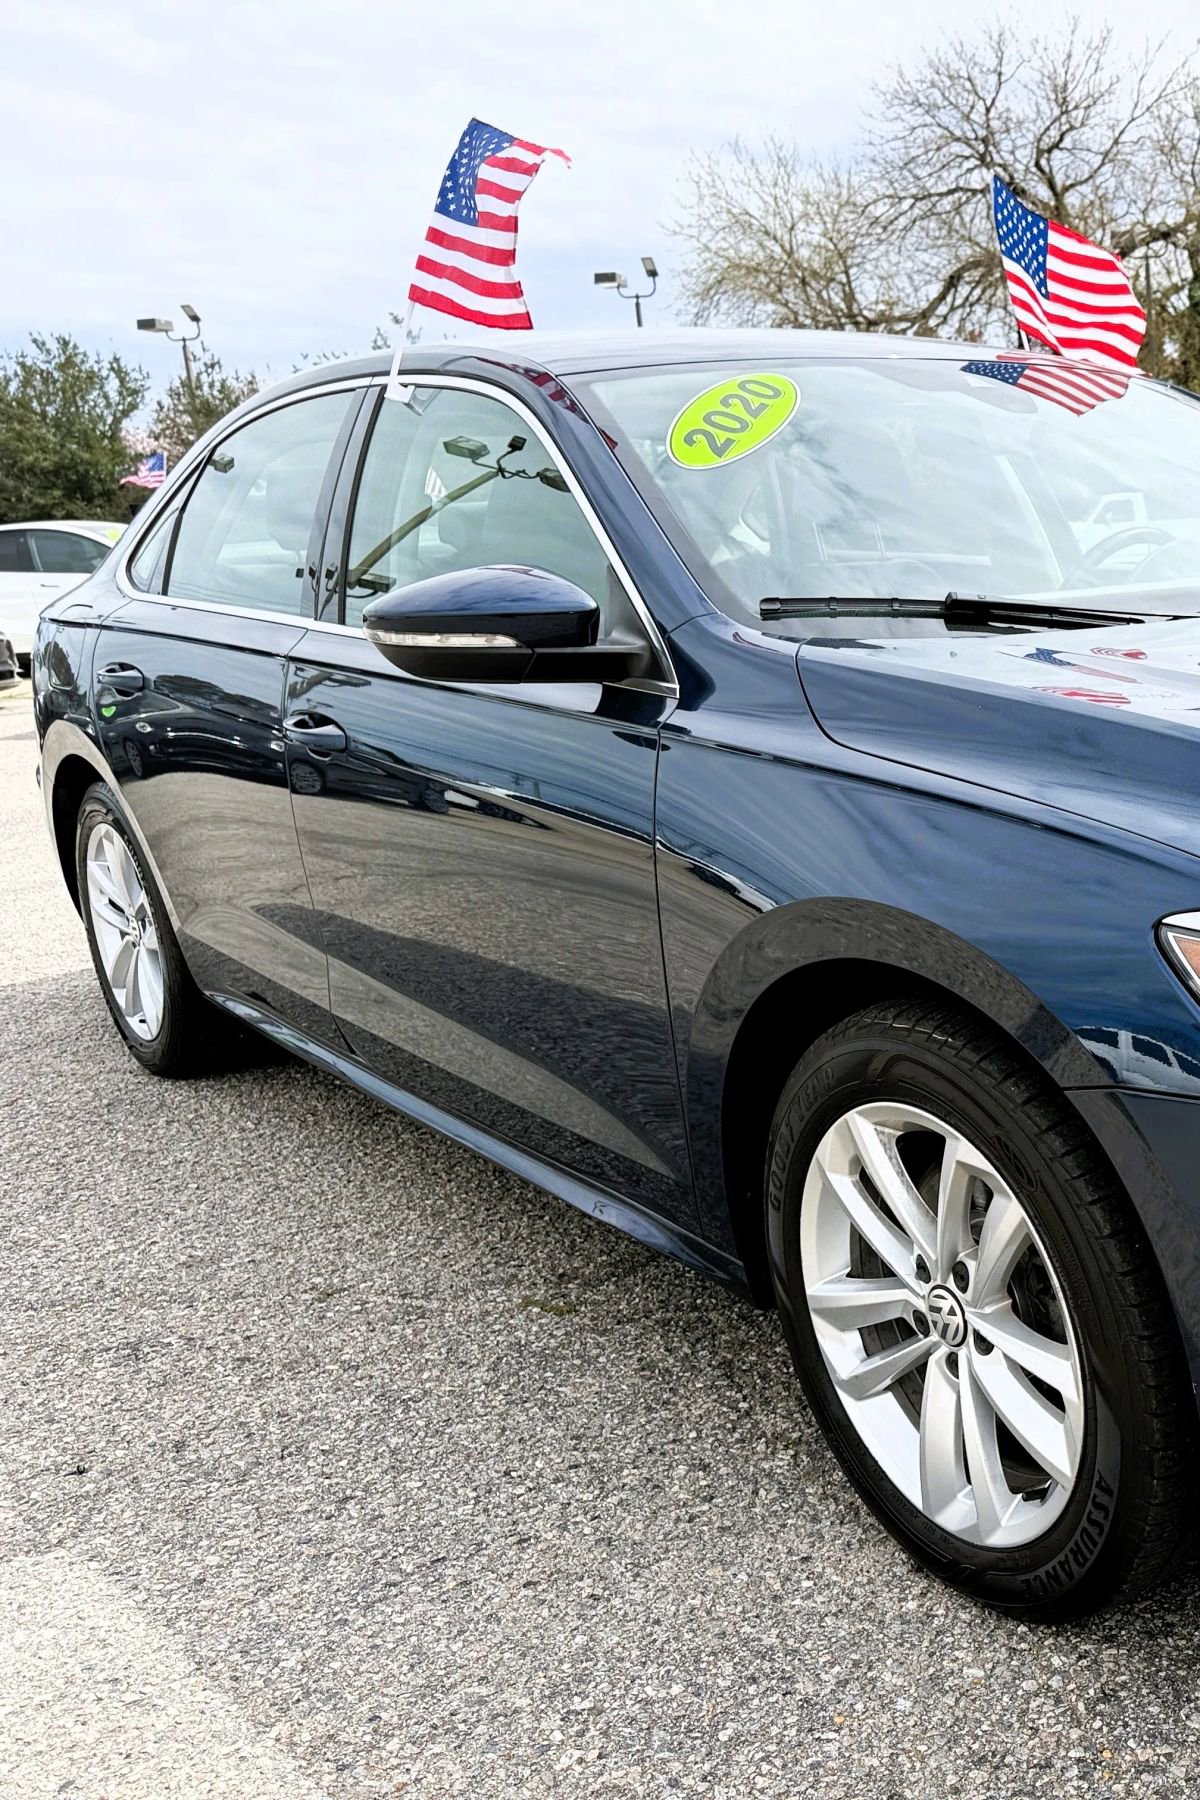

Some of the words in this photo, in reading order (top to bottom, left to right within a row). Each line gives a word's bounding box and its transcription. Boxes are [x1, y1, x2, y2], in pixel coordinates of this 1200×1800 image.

[683, 379, 785, 459] 2020
[769, 1067, 834, 1214] GOODYEAR
[1019, 1470, 1116, 1598] ASSURANCE
